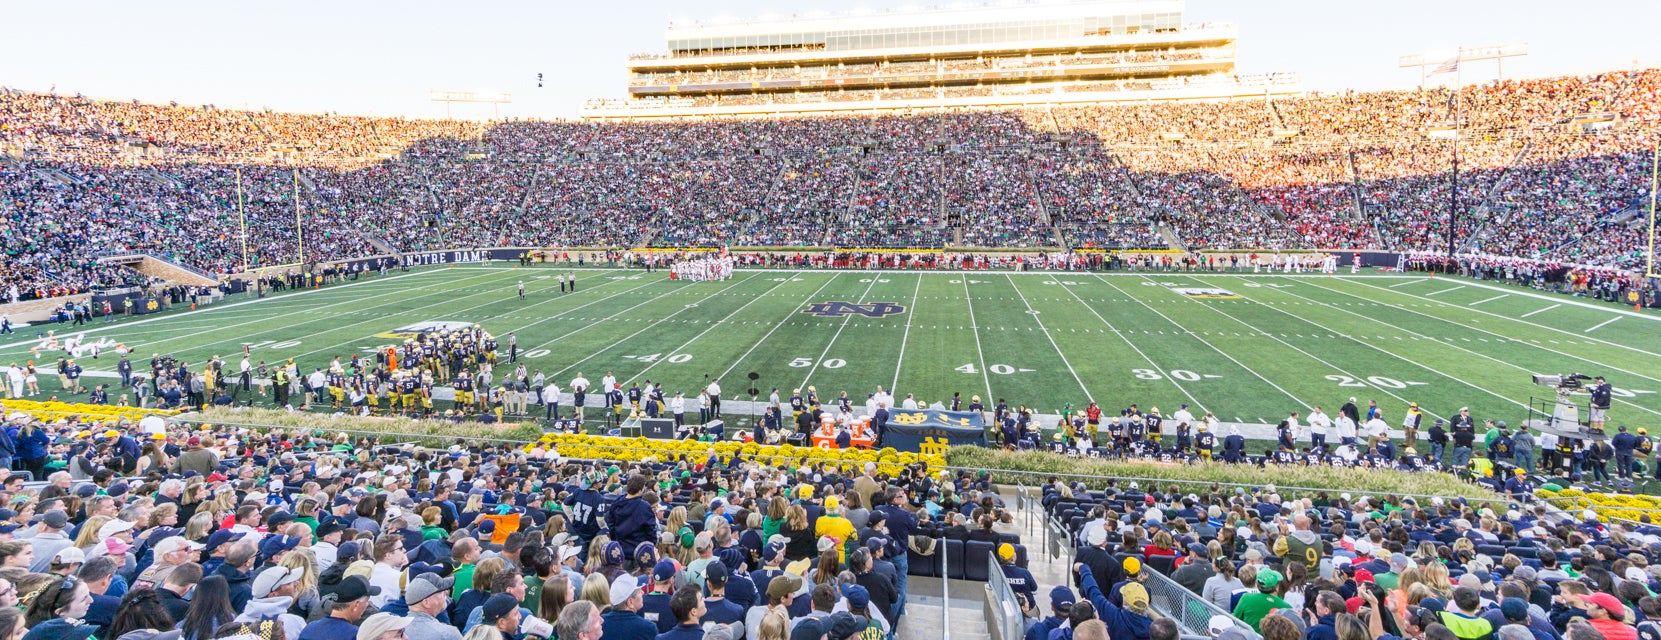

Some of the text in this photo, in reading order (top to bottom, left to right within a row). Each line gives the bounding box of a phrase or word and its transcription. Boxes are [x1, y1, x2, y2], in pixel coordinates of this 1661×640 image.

[637, 353, 693, 363] 40
[788, 357, 847, 369] 50
[954, 363, 1015, 375] 40
[1132, 368, 1201, 381] 30
[1325, 375, 1407, 389] 20
[1148, 418, 1158, 426] 37
[818, 440, 830, 450] G
[1201, 436, 1211, 445] 45
[1161, 453, 1171, 462] 22
[1279, 453, 1292, 462] 94
[1331, 457, 1343, 467] 25
[1373, 458, 1386, 467] 54
[573, 501, 593, 525] 47
[1305, 547, 1318, 569] 9
